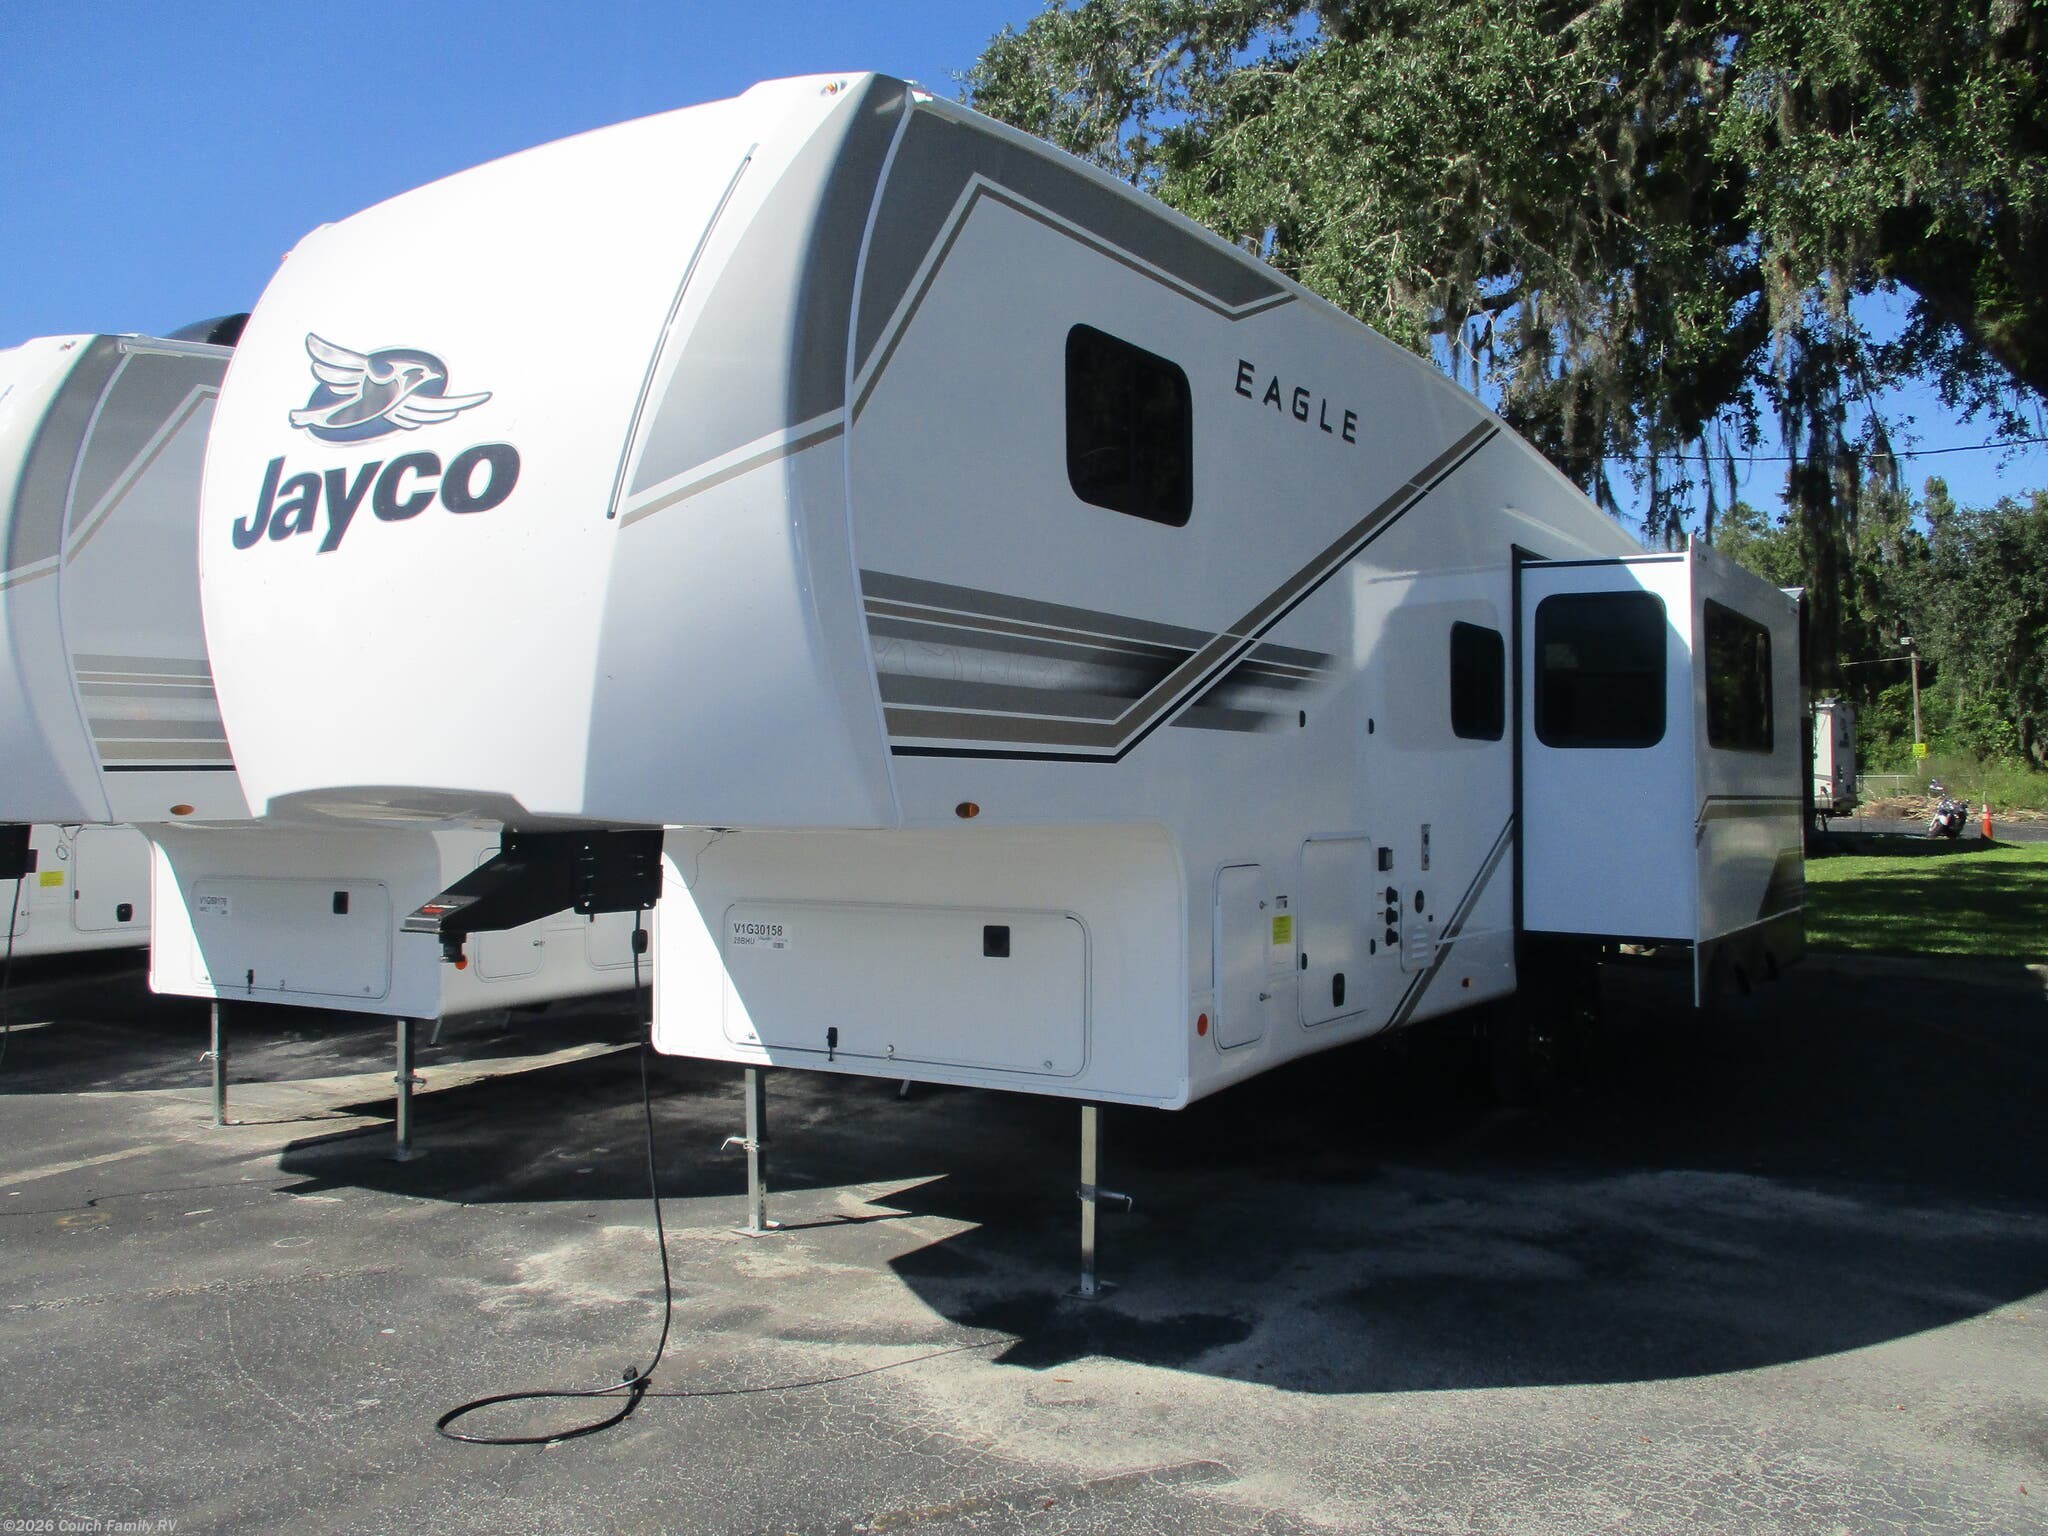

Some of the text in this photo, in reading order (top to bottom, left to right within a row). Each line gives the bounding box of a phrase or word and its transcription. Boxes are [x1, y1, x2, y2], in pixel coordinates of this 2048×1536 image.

[1235, 358, 1358, 445] EAGLE
[231, 441, 520, 554] Jayco
[733, 923, 783, 936] V1G30158
